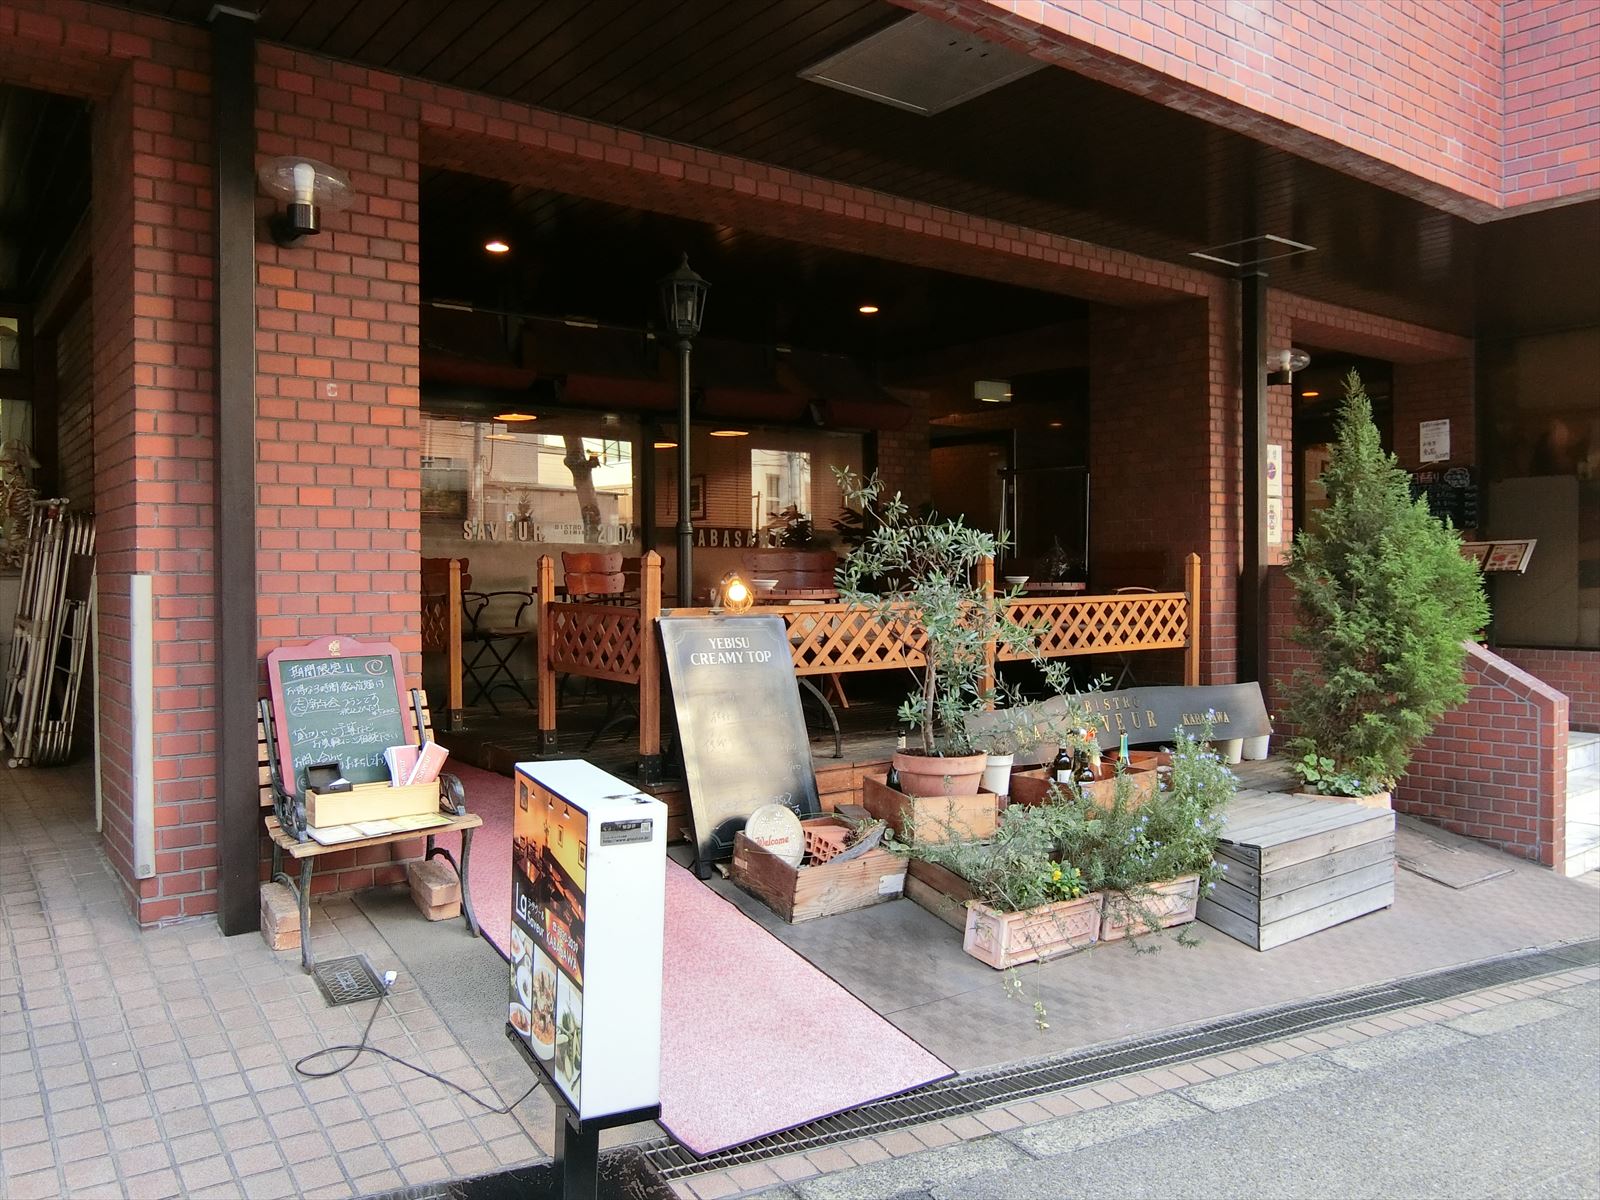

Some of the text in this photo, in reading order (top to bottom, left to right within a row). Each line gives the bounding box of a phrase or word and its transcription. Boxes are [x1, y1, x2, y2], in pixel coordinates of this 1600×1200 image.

[463, 520, 544, 542] SAVEUR
[597, 523, 635, 545] 2004
[708, 637, 750, 650] YEBISU
[690, 650, 772, 666] CREAMY TOP
[1182, 711, 1230, 725] KABAAWA
[755, 835, 789, 847] Welcome
